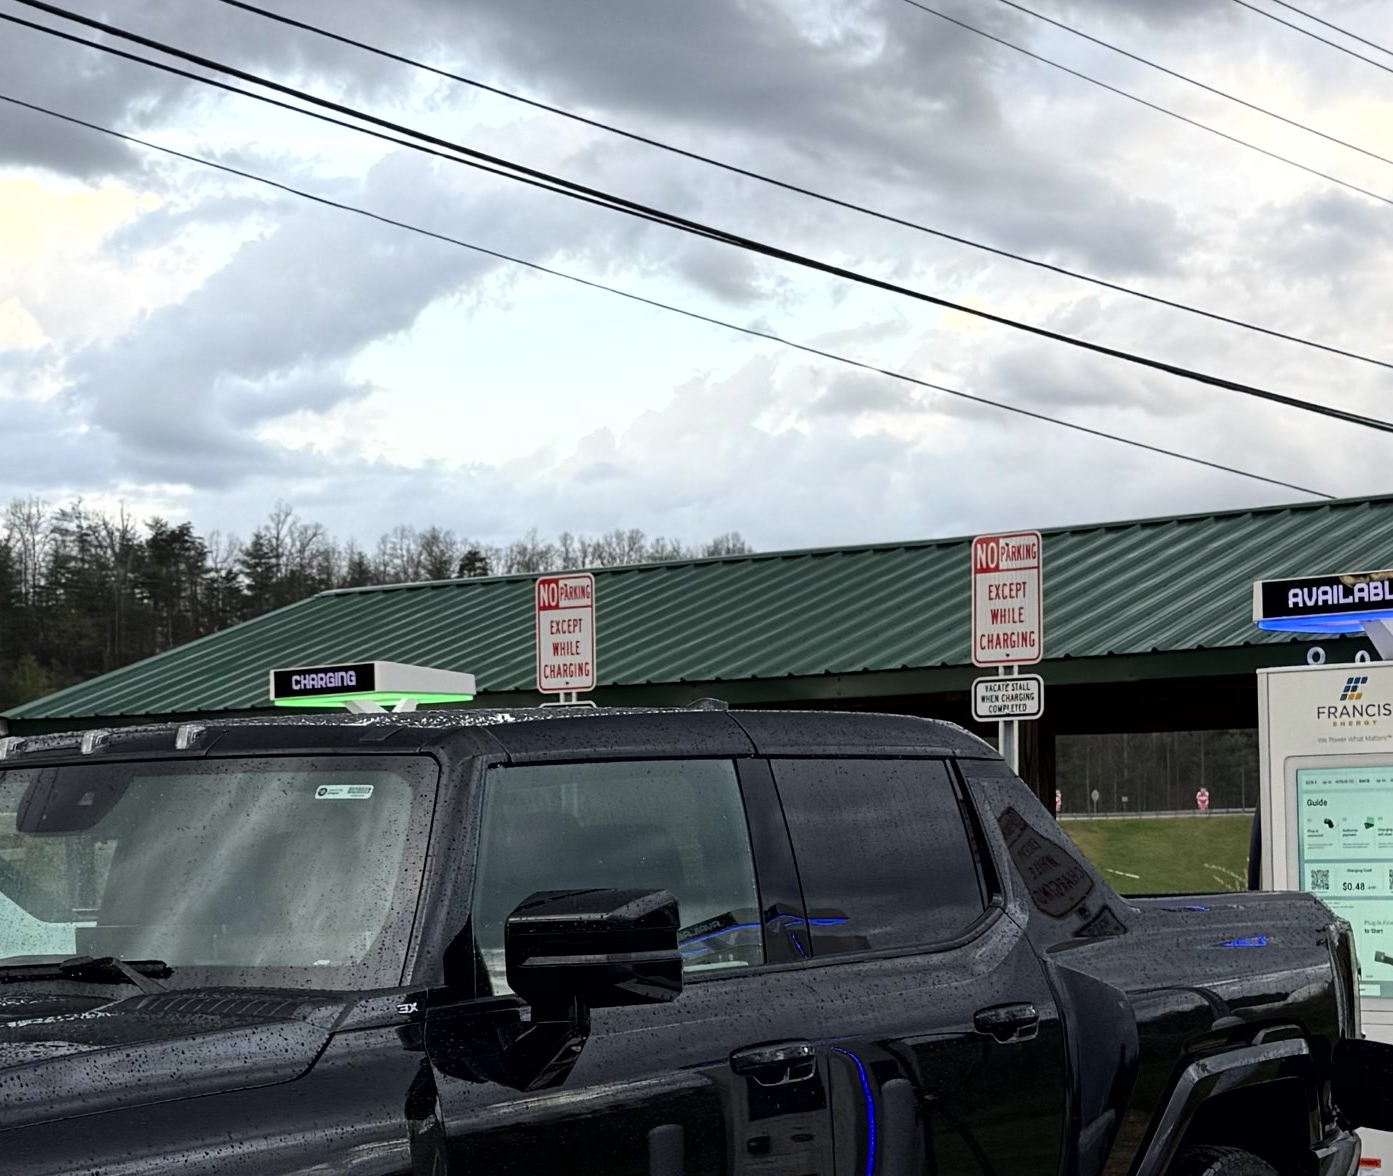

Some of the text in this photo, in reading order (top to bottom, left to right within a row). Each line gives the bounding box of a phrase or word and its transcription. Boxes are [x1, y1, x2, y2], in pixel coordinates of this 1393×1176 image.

[976, 542, 1037, 570] NO PARKING
[539, 583, 590, 607] NO PARKING
[988, 581, 1027, 601] EXCEPT
[990, 606, 1025, 625] WHILE
[550, 618, 583, 635] EXCEPT
[552, 640, 581, 657] WHILE
[979, 631, 1035, 651] CHARGING
[543, 662, 590, 679] CHARGING
[291, 670, 356, 691] CHARGING
[984, 682, 1031, 692] VACATE STALL
[981, 692, 1035, 703] WHEN CHARGING
[988, 703, 1027, 713] COMPLETED
[1317, 703, 1392, 719] FRANCIS
[1307, 798, 1328, 807] Guide
[1342, 882, 1365, 891] $0.48
